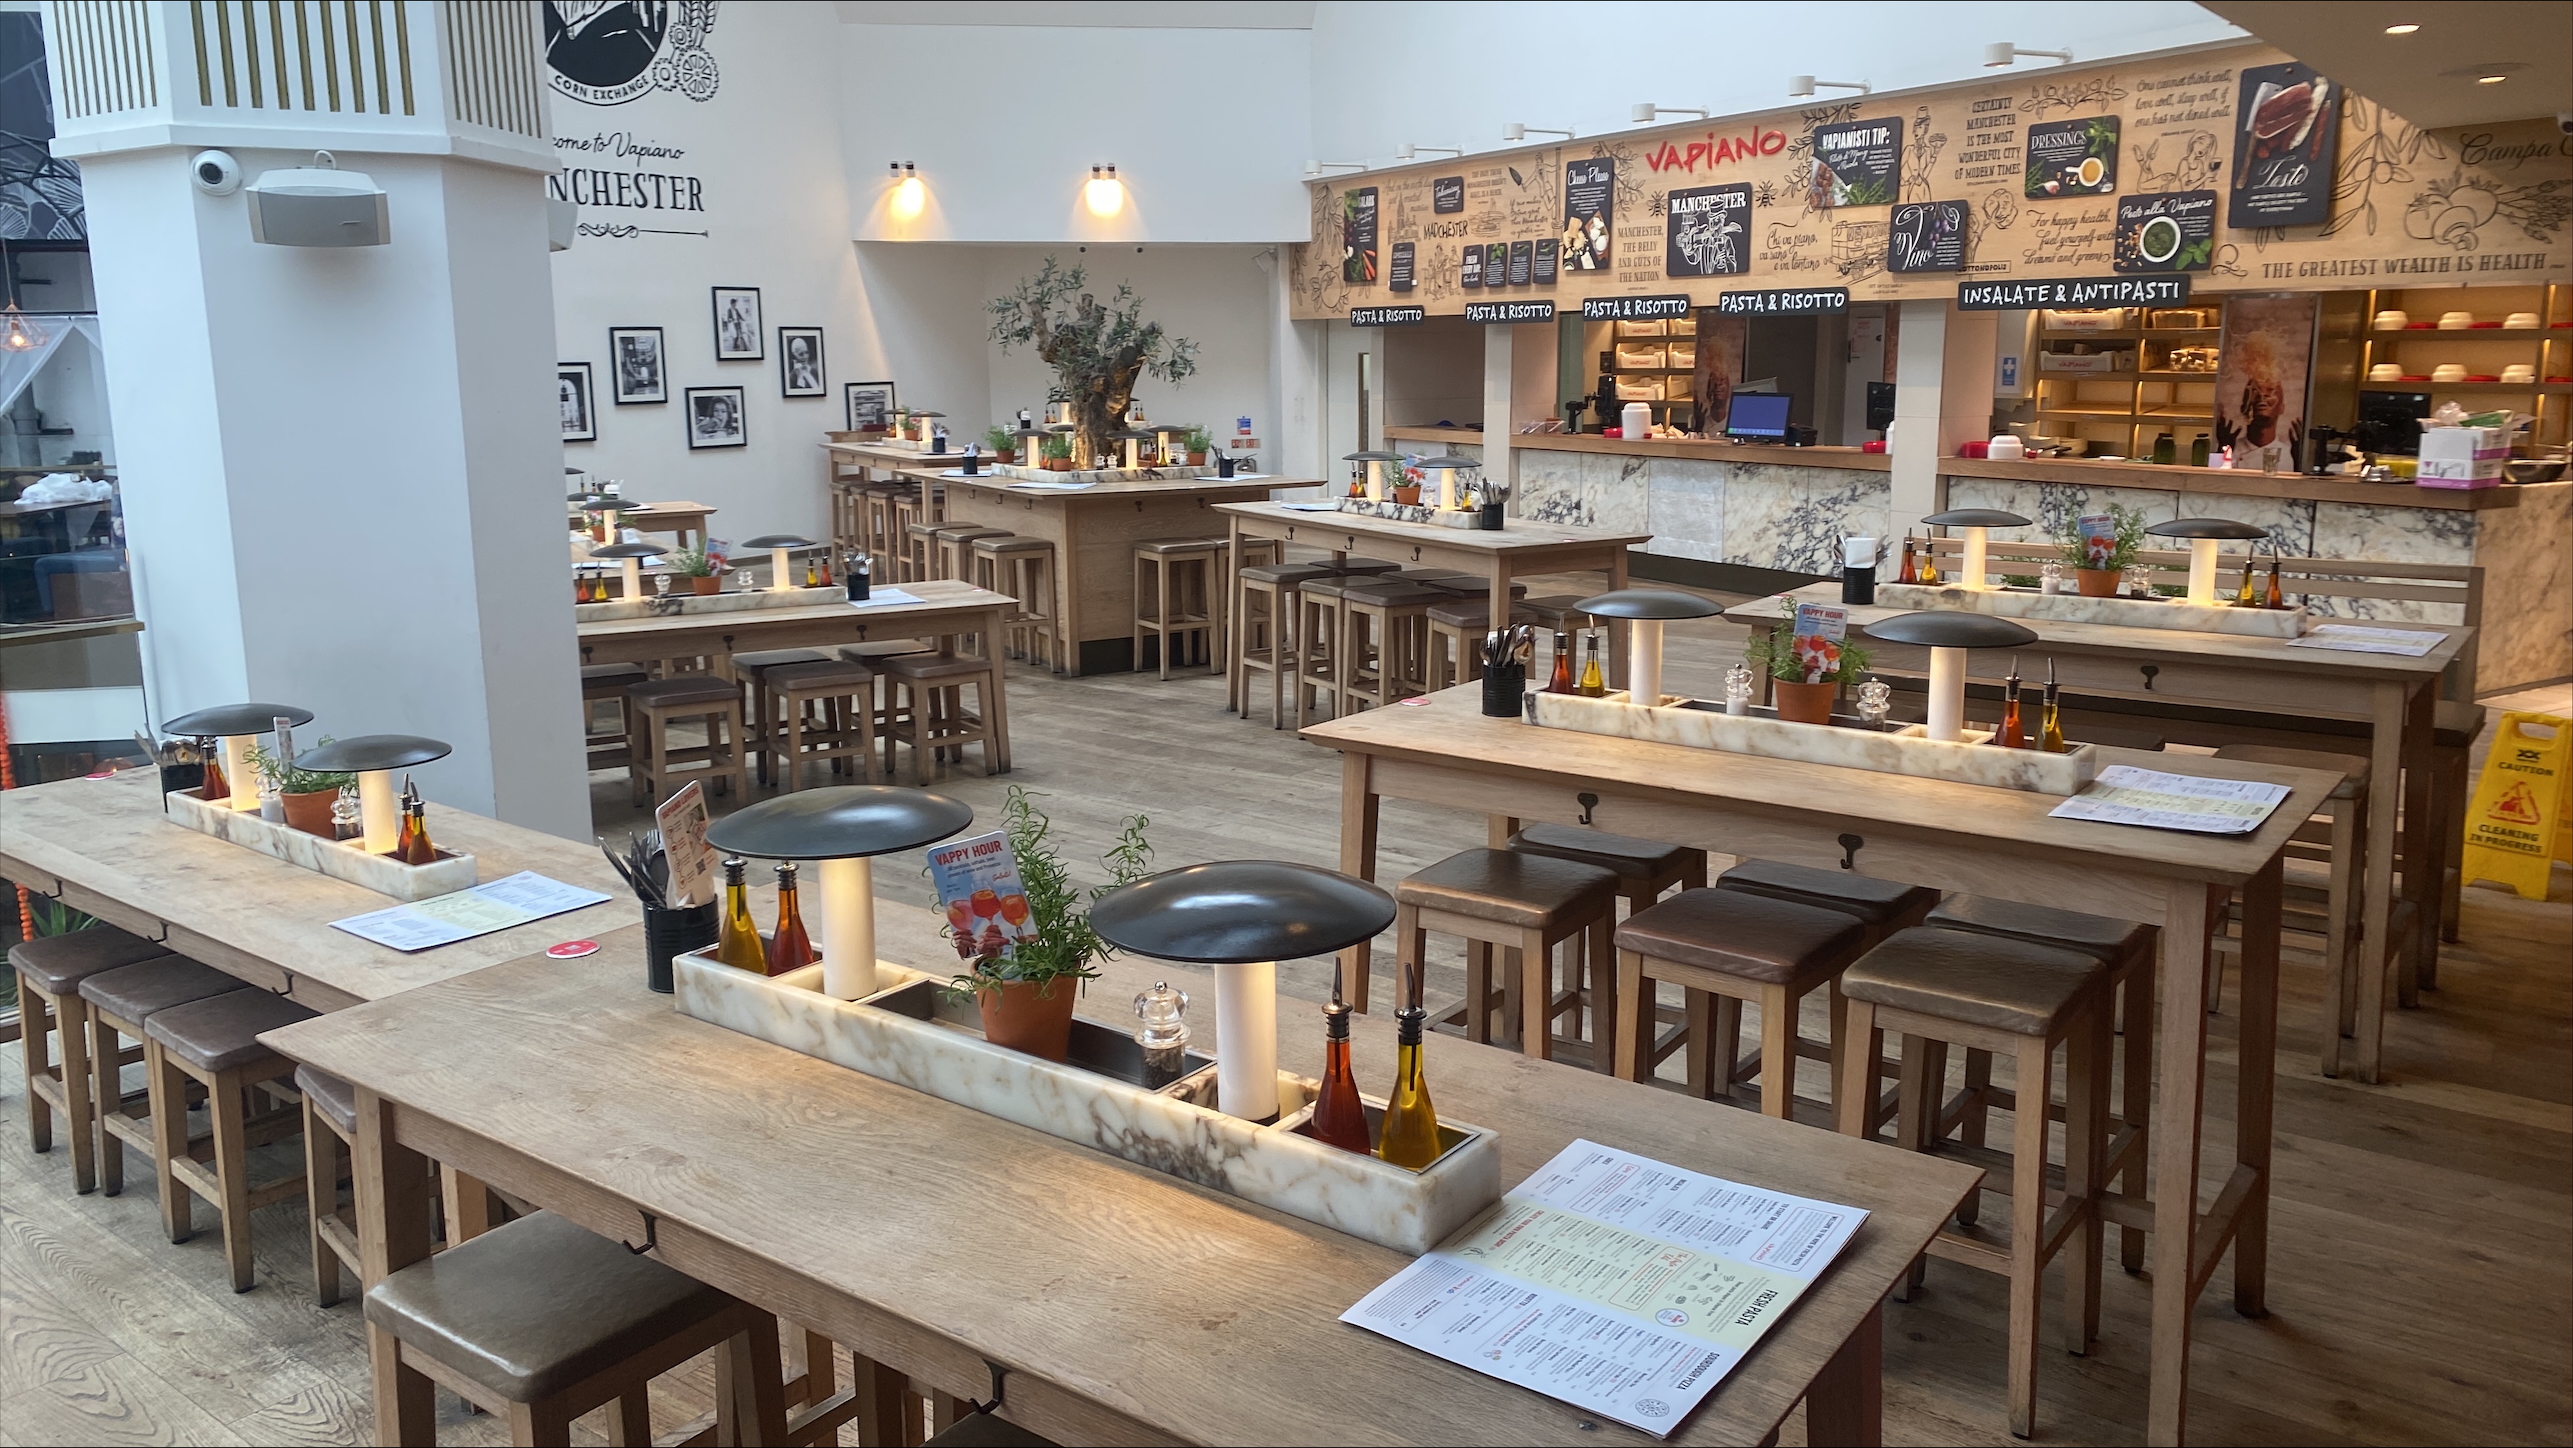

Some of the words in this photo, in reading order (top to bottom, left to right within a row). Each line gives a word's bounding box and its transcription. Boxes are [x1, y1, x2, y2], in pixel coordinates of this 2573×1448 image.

[554, 75, 587, 98] CORN
[593, 75, 649, 100] EXCHANGE
[1967, 114, 2016, 130] MANCHESTER
[1822, 130, 1870, 150] VAPIANISTI
[1872, 127, 1890, 146] TIP:
[1967, 135, 1974, 147] IS
[1977, 133, 1991, 146] THE
[1993, 131, 2014, 144] MOST
[2031, 130, 2087, 150] DRESSINGS
[593, 132, 609, 153] to
[609, 132, 685, 167] Vapiano
[1646, 126, 1787, 173] VAPIANO
[1958, 149, 2000, 163] WONDERFUL
[2003, 147, 2022, 159] CITY
[1954, 168, 1963, 180] OF
[1965, 165, 1994, 178] MODERN
[1671, 191, 1747, 214] MANCHESTER
[2121, 205, 2143, 219] Pesto
[2144, 201, 2166, 216] alla
[2167, 199, 2213, 216] Vapiano
[2026, 209, 2049, 228] For
[2050, 210, 2078, 230] happy
[2079, 208, 2111, 225] health,
[1424, 220, 1468, 240] MADCHESTER
[1767, 230, 1780, 250] Chi
[2059, 229, 2096, 251] yourself
[1623, 242, 1636, 253] THE
[1638, 241, 1658, 252] BELLY
[1619, 258, 1632, 268] AND
[1633, 257, 1651, 267] GUTS
[1653, 256, 1662, 266] OF
[2057, 252, 2074, 265] and
[2263, 262, 2293, 279] THE
[2299, 260, 2378, 278] GREATEST
[2384, 257, 2451, 275] WEALTH
[2457, 256, 2473, 272] IS
[2479, 253, 2547, 272] HEALTH
[1619, 272, 1633, 283] THE
[1634, 271, 1660, 281] NATION
[1721, 293, 1764, 313] PASTA
[1767, 292, 1777, 310] &
[1781, 291, 1845, 311] RISOTTO
[1964, 284, 2051, 305] INSALATE
[2055, 284, 2067, 302] &
[2072, 281, 2179, 304] ANTIPASTI
[1351, 310, 1377, 324] PASTA
[1378, 310, 1385, 322] &
[1386, 309, 1422, 322] RISOTTO
[1466, 305, 1497, 321] PASTA
[1499, 305, 1506, 318] &
[1508, 304, 1552, 319] RISOTTO
[1584, 301, 1622, 317] PASTA
[1624, 301, 1631, 316] &
[1634, 299, 1687, 315] RISOTTO
[1802, 607, 1825, 617] VAPPY
[1825, 611, 1844, 620] HOUR
[2498, 761, 2555, 777] CAUTION
[2478, 823, 2540, 843] CLEANING
[935, 847, 970, 866] VAPPY
[972, 840, 1003, 858] HOUR
[2469, 833, 2484, 843] IN
[2484, 835, 2542, 854] PROGRESS
[1751, 1288, 1778, 1307] FRESH
[1733, 1305, 1763, 1326] PASTA
[1687, 1351, 1720, 1378] SOURDOUGH
[1675, 1376, 1695, 1391] PIZZA
